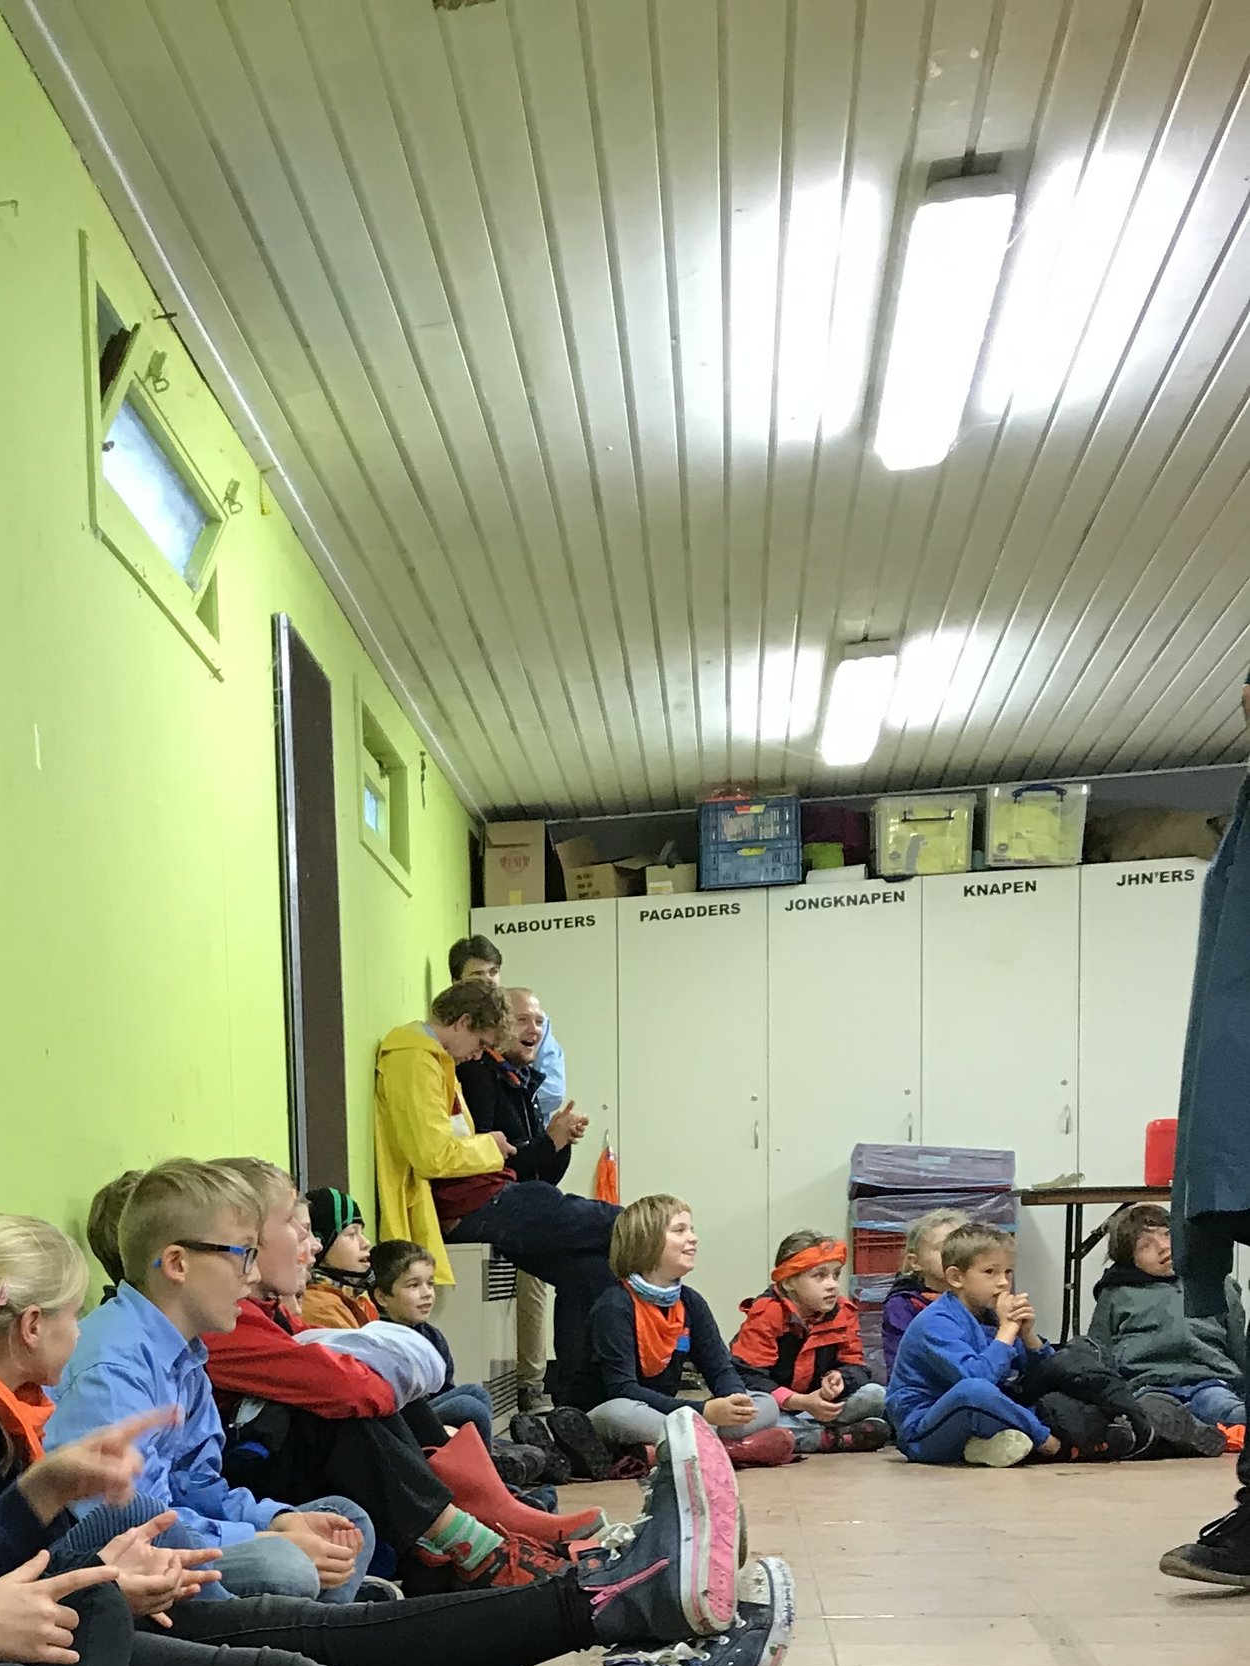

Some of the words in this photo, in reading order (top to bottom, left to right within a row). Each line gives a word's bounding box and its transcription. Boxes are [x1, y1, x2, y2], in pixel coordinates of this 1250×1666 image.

[1116, 869, 1195, 886] JHN'ERS
[963, 880, 1037, 897] KNAPEN
[784, 890, 906, 912] JONGKNAPEN
[639, 903, 741, 922] PAGADDERS
[494, 915, 596, 935] KABOUTERS
